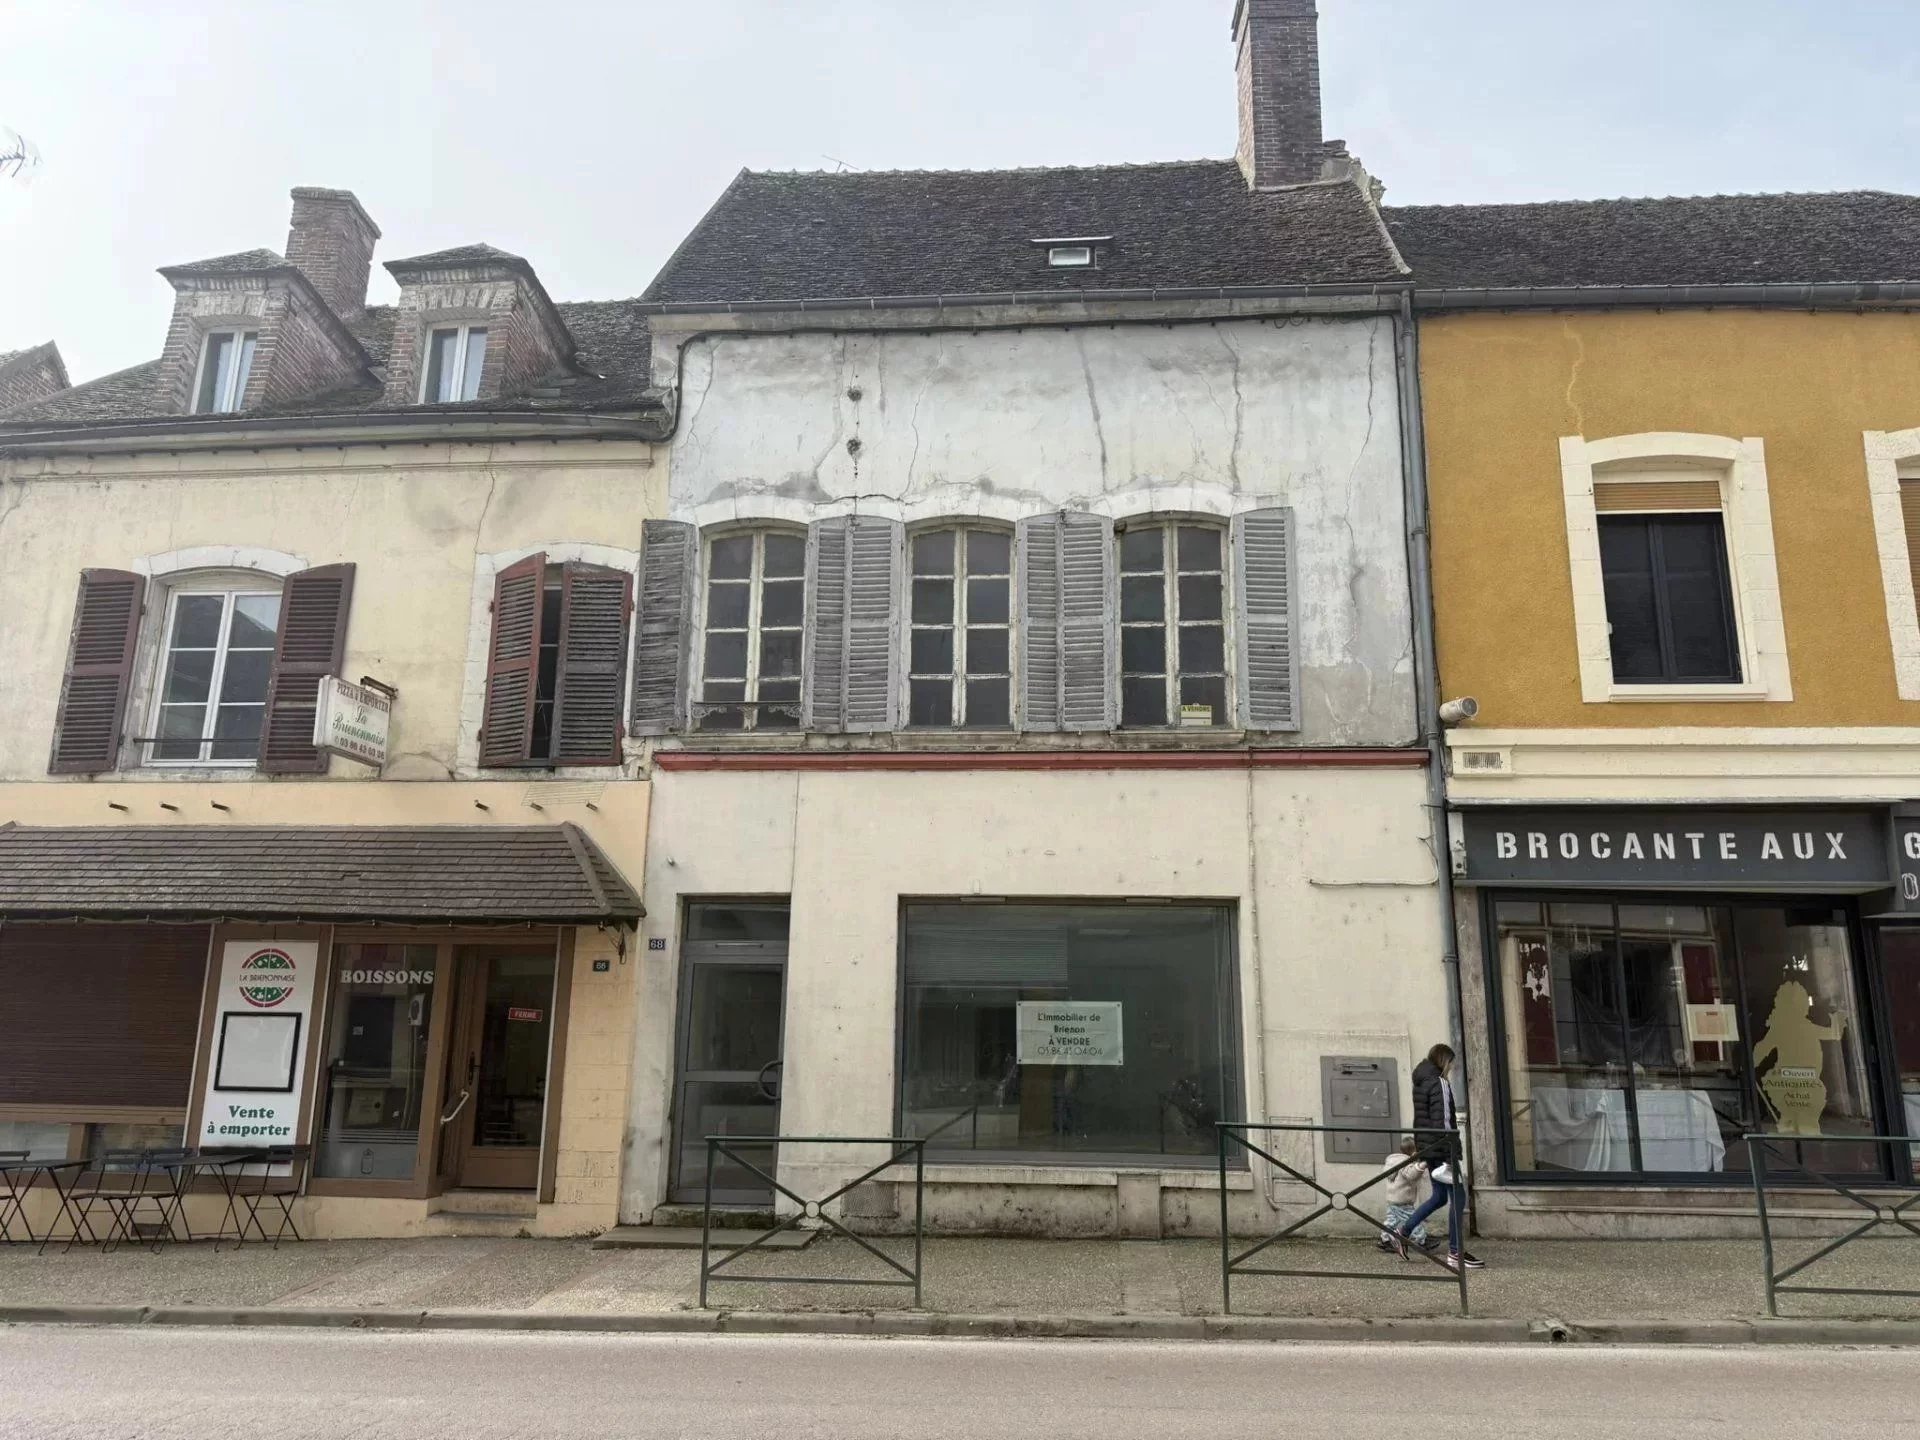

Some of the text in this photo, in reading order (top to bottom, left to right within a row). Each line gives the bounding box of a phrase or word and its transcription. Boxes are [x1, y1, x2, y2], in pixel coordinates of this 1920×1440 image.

[337, 682, 353, 698] PIZZA
[355, 705, 368, 725] La
[1497, 832, 1847, 860] BROCANTE AUX
[650, 940, 664, 949] 68
[341, 970, 434, 984] BOISSONS
[1089, 1013, 1101, 1021] de
[1056, 1037, 1090, 1046] VENDRE
[228, 1105, 275, 1119] Vente
[207, 1121, 290, 1138] à emporter
